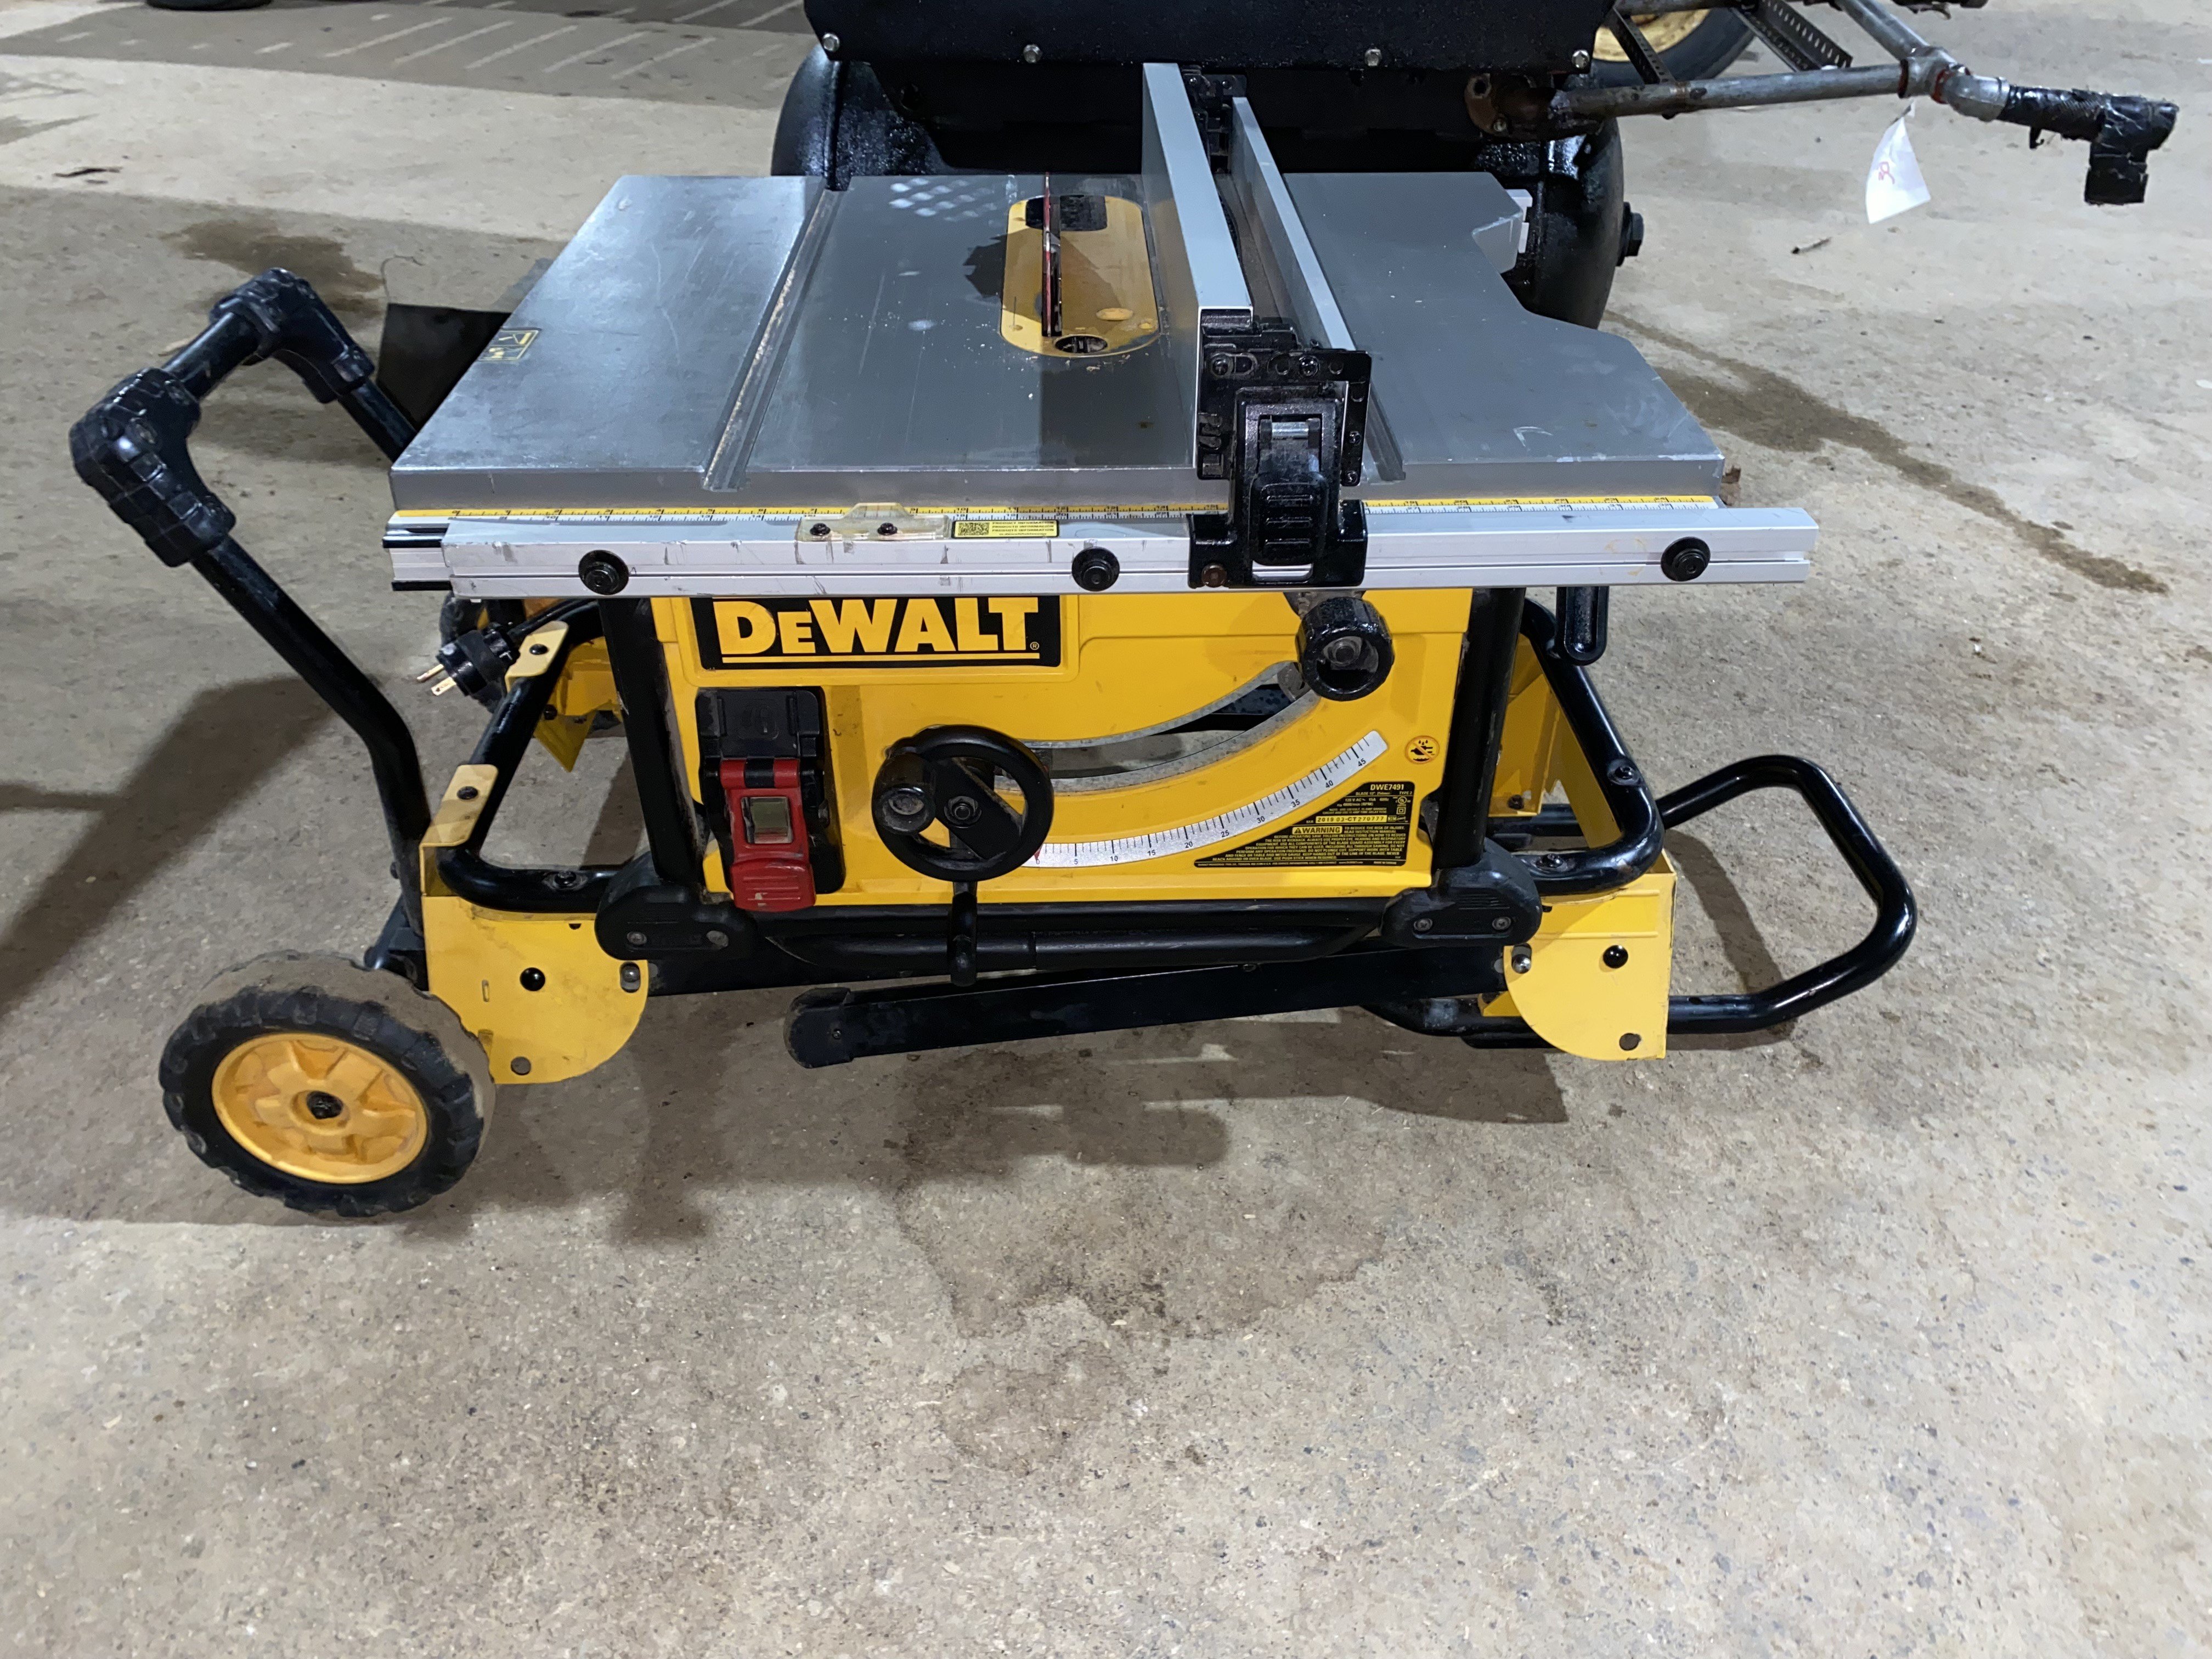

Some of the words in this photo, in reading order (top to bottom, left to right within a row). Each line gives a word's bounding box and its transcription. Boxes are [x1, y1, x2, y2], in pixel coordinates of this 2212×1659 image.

[1221, 830, 1229, 838] 25
[1291, 799, 1300, 808] 35
[1325, 780, 1334, 788] 40
[1357, 758, 1366, 767] 45
